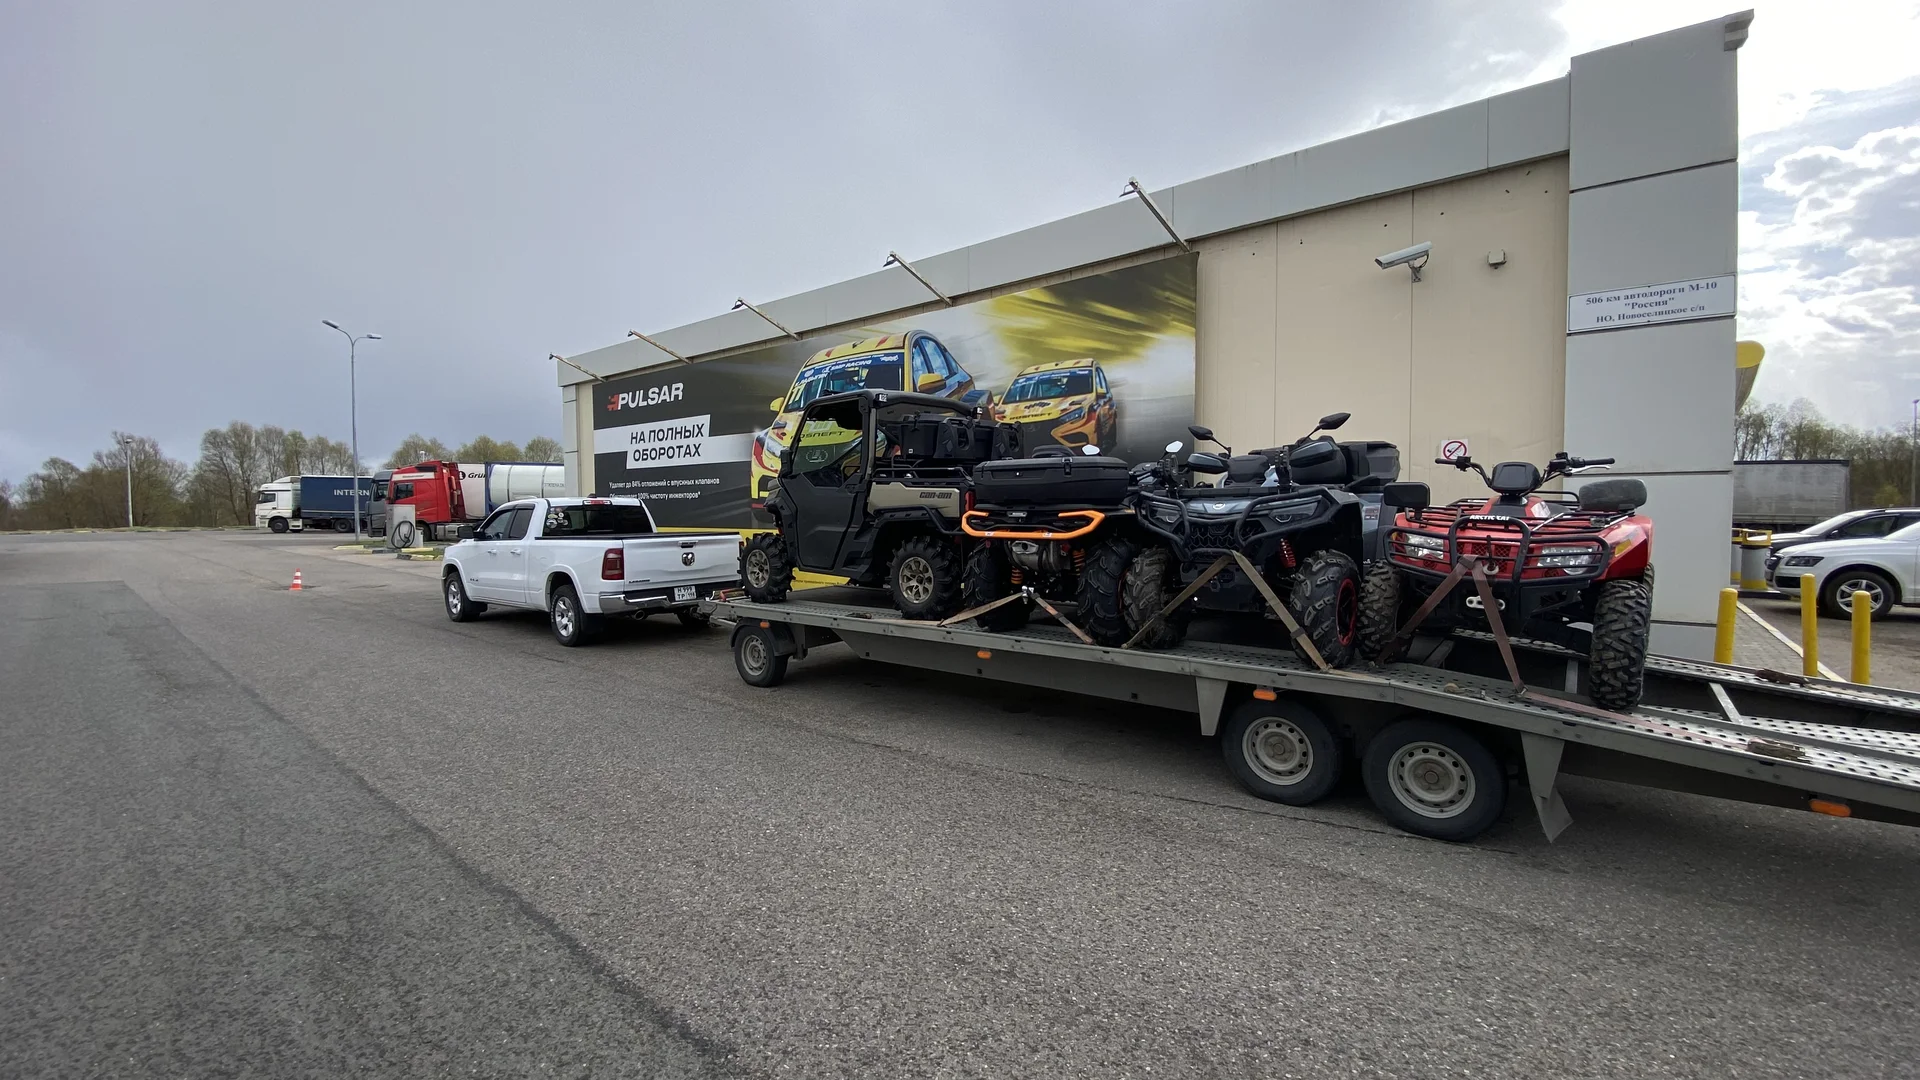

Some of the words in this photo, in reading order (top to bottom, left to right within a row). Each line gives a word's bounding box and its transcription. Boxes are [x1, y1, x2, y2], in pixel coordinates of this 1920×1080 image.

[1586, 297, 1603, 305] 506
[1624, 287, 1685, 300] автодороги
[1689, 281, 1717, 291] М-10
[1618, 307, 1687, 320] Новоселицкое
[1690, 304, 1705, 312] с/п
[1625, 297, 1674, 310] "Россия"
[617, 382, 684, 410] PULSAR
[630, 431, 646, 445] НА
[648, 423, 704, 443] ПОЛНЫХ
[633, 443, 702, 462] ОБОРОТАХ
